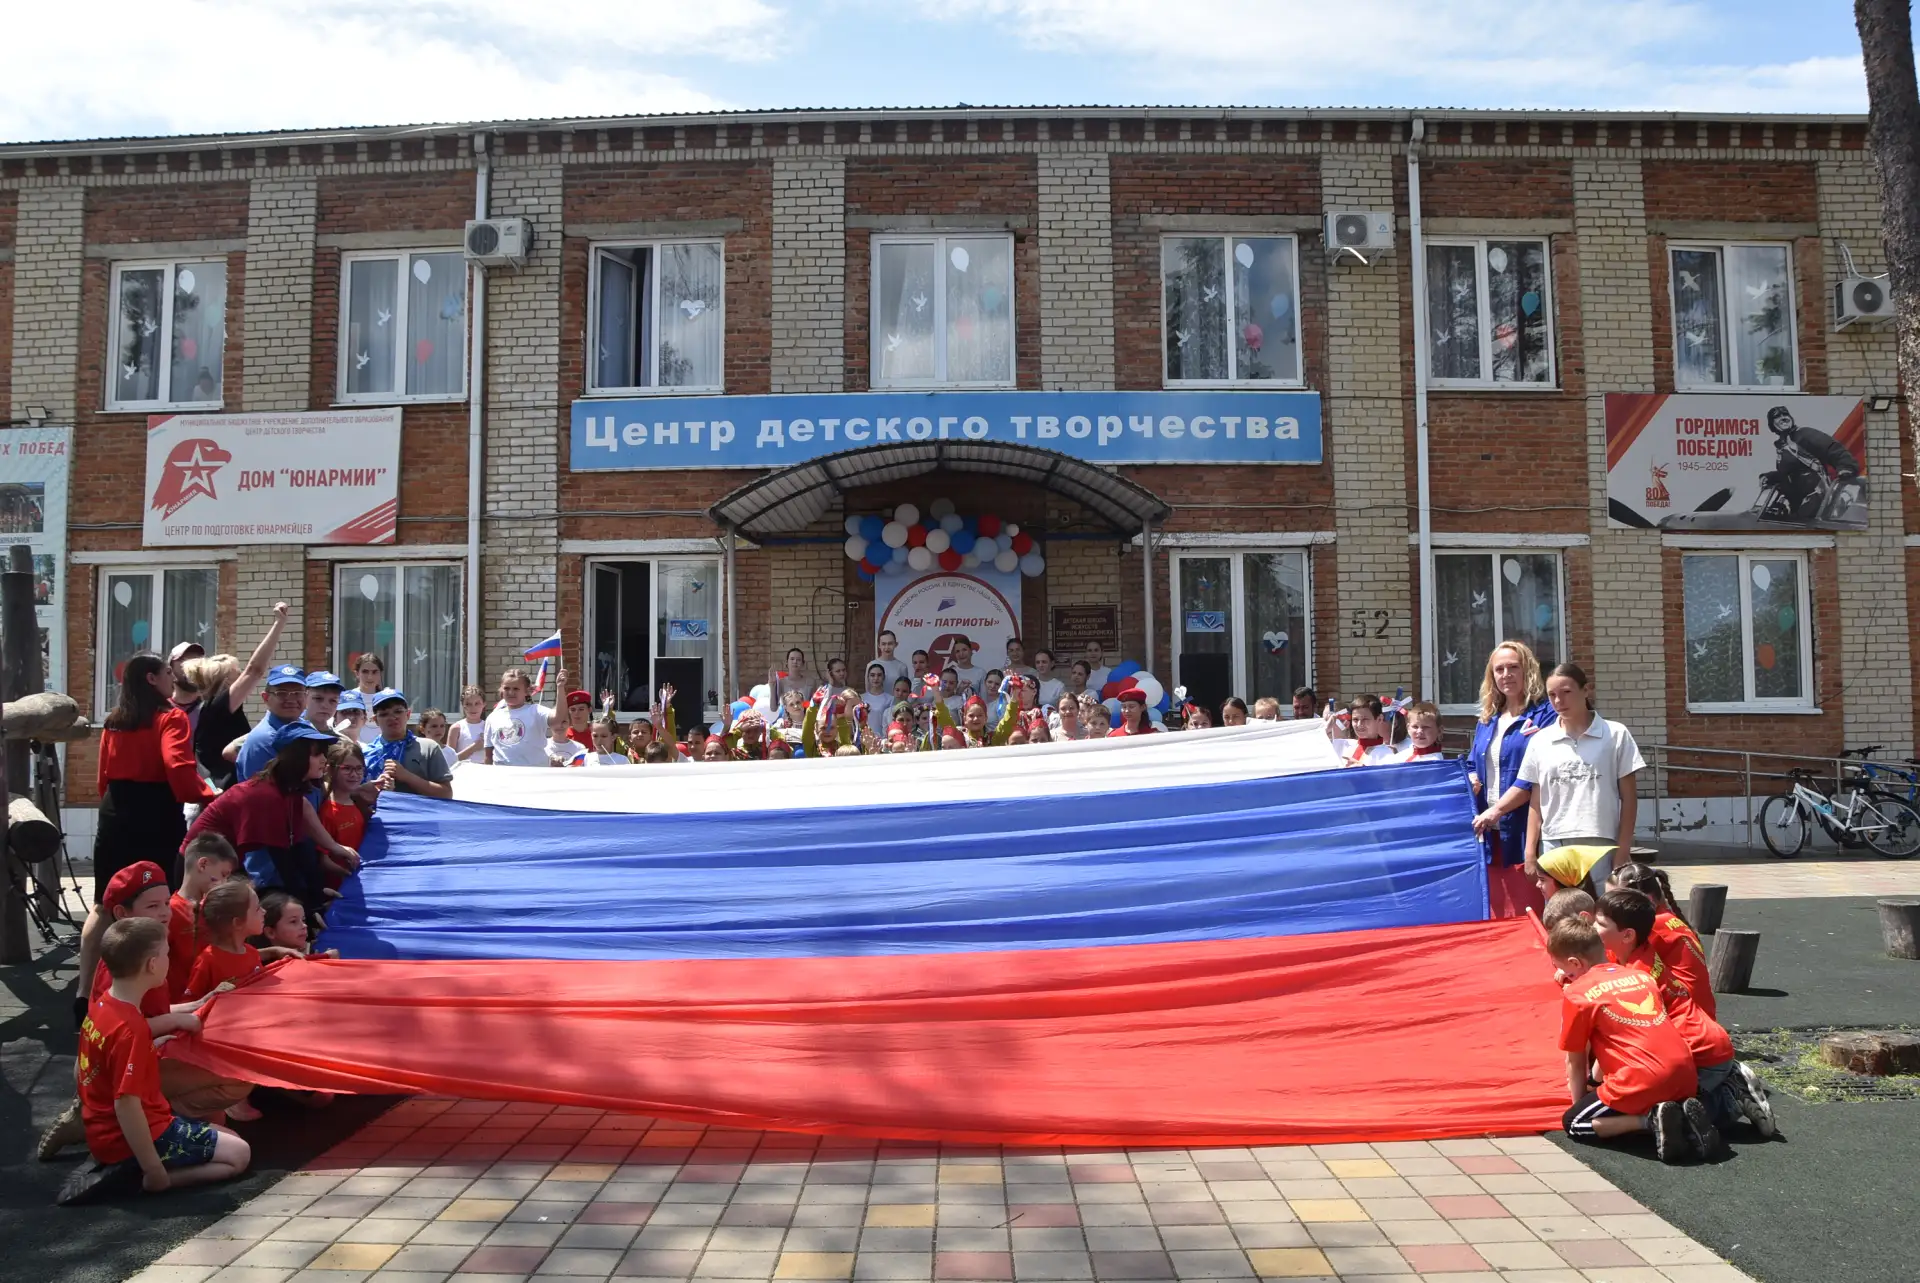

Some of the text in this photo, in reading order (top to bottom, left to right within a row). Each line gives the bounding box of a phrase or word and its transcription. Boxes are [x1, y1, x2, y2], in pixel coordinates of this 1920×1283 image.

[585, 415, 1300, 452] Центр детского творчества
[1675, 418, 1760, 438] ГОРДИМСЯ
[18, 442, 65, 456] ПОБЕД
[1676, 438, 1753, 459] ПОБЕДОЙ!
[237, 470, 275, 492] ДОМ
[166, 488, 198, 515] ЮНАРМИЯ
[1645, 487, 1659, 500] 80
[1645, 500, 1671, 508] ПОБЕДА!
[164, 522, 313, 538] ЦЕНТР ПО ПОДГОТОВКЕ ЮНАРМЕЙЦЕВ
[1351, 610, 1390, 640] 52
